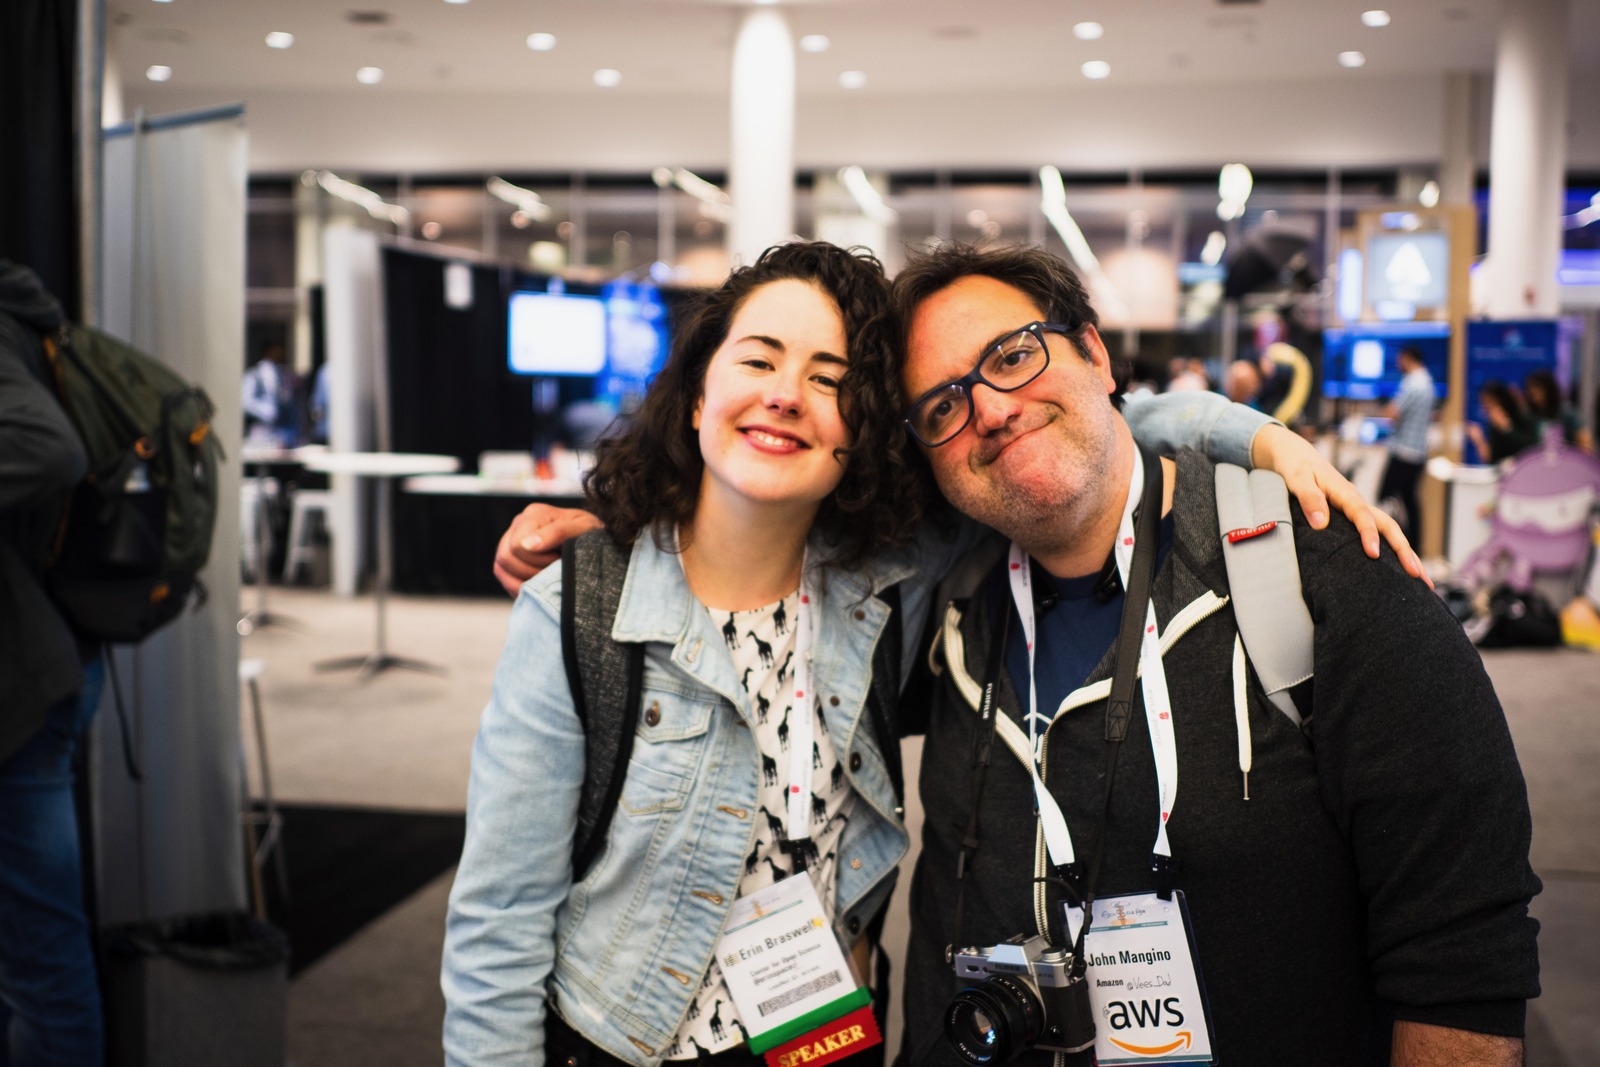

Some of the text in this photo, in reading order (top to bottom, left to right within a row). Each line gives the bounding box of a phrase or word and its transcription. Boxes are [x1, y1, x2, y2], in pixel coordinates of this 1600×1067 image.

[982, 682, 993, 720] FUJIFILM
[739, 945, 764, 961] Erin
[1088, 948, 1171, 967] John Mangino
[1096, 979, 1124, 988] Amazon
[1108, 997, 1185, 1030] aws
[778, 1023, 866, 1067] SPEAKER
